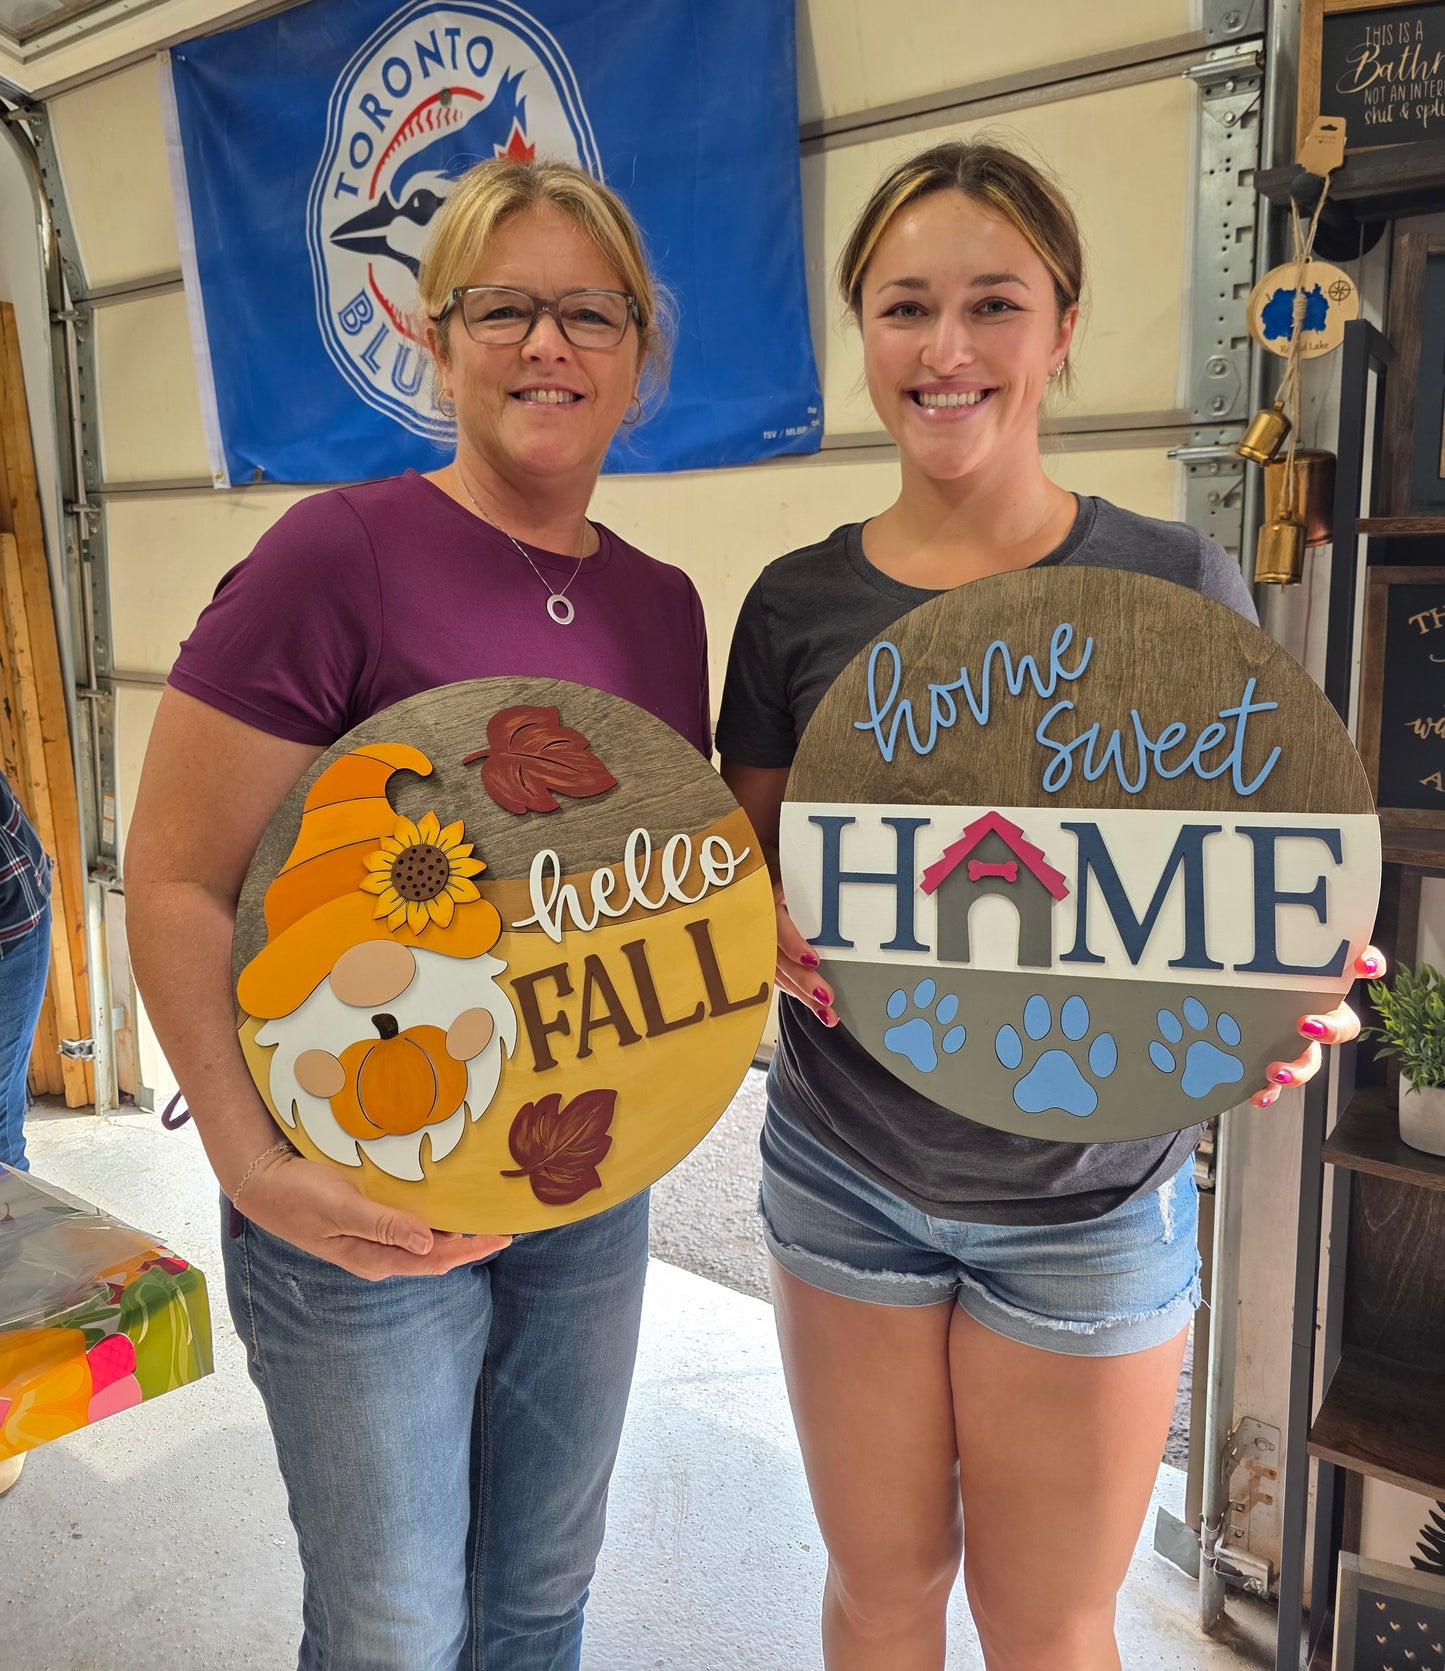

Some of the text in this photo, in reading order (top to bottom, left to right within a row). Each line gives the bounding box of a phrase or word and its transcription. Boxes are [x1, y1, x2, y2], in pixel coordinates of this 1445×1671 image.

[1364, 79, 1445, 105] NOT AN INTER
[1365, 19, 1423, 48] THIS IS A
[333, 27, 494, 199] TORONTO
[854, 622, 1094, 763] home
[1036, 677, 1282, 796] sweet
[511, 828, 750, 943] hello
[510, 918, 769, 1073] FALL
